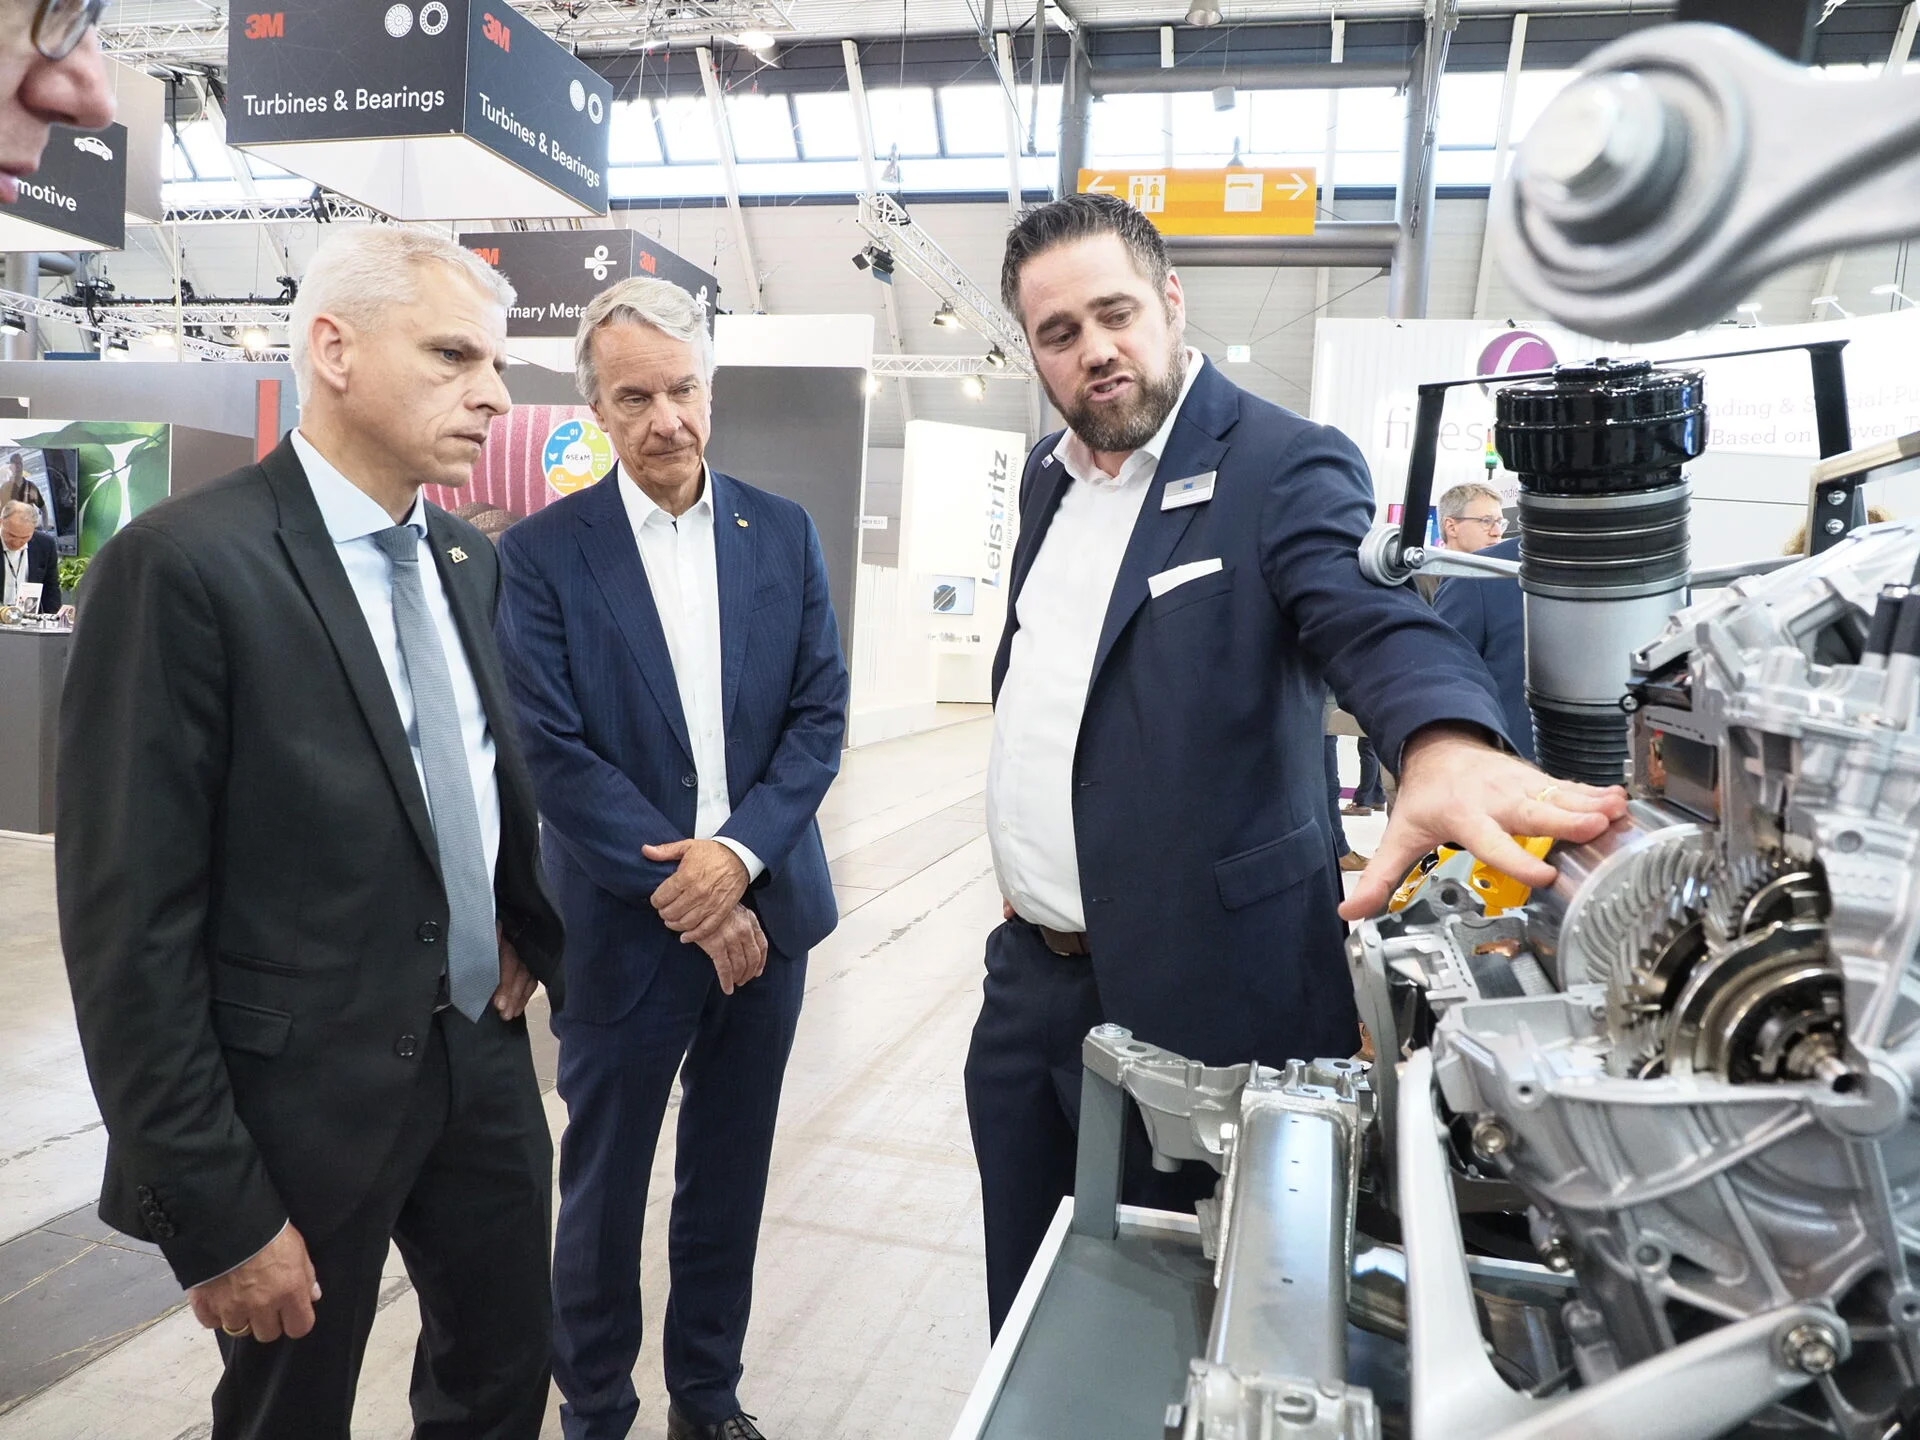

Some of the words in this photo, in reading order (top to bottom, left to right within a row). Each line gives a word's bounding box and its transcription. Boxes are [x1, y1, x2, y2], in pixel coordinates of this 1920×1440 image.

[244, 13, 284, 39] 3M
[482, 12, 511, 53] 3M
[242, 92, 328, 116] Turbines
[333, 89, 349, 111] &
[355, 85, 445, 112] Bearings
[479, 91, 536, 147] Turbines
[538, 132, 549, 156] &
[551, 139, 600, 188] Bearings
[17, 179, 78, 212] motive
[639, 250, 657, 275] 3M
[505, 302, 546, 321] mary
[549, 302, 588, 318] Meta
[1779, 397, 1795, 414] &
[1383, 406, 1484, 452] fies
[1711, 424, 1777, 446] Based
[1784, 430, 1812, 444] on
[1009, 456, 1017, 483] TOOLS
[981, 449, 1007, 588] Leistritz
[1007, 485, 1016, 527] PRECISION
[1006, 529, 1014, 550] HIGH
